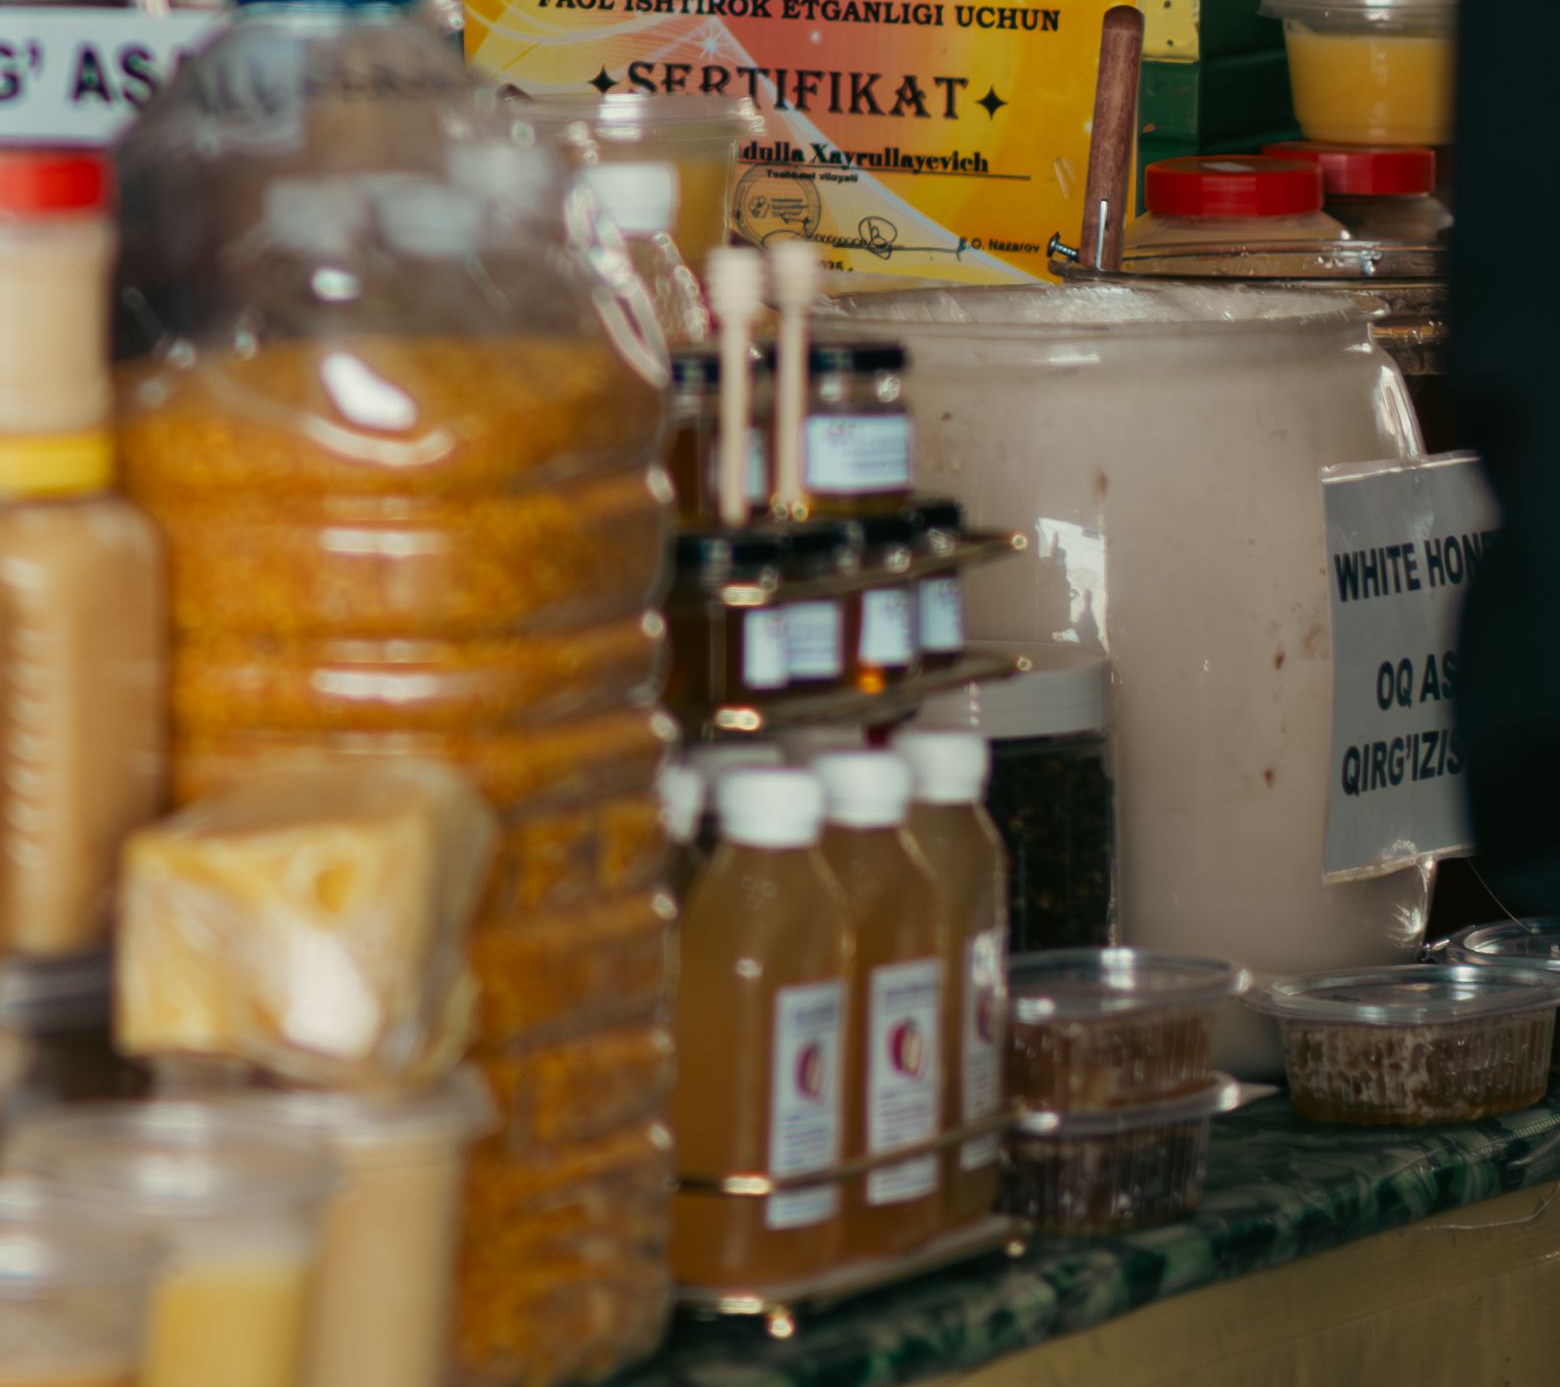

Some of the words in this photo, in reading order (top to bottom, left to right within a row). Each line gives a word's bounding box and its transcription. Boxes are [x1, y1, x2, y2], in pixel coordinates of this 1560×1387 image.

[954, 5, 1062, 33] UCHUN
[627, 60, 970, 121] SERTIFIKAT
[739, 140, 805, 163] dulla
[810, 142, 989, 175] Xayrullayevich
[989, 238, 1041, 254] Nazarov
[1334, 542, 1421, 603] WHITE
[1376, 658, 1413, 711] OQ
[1420, 651, 1457, 703] AS
[1341, 729, 1465, 797] QIRG'IZIS
